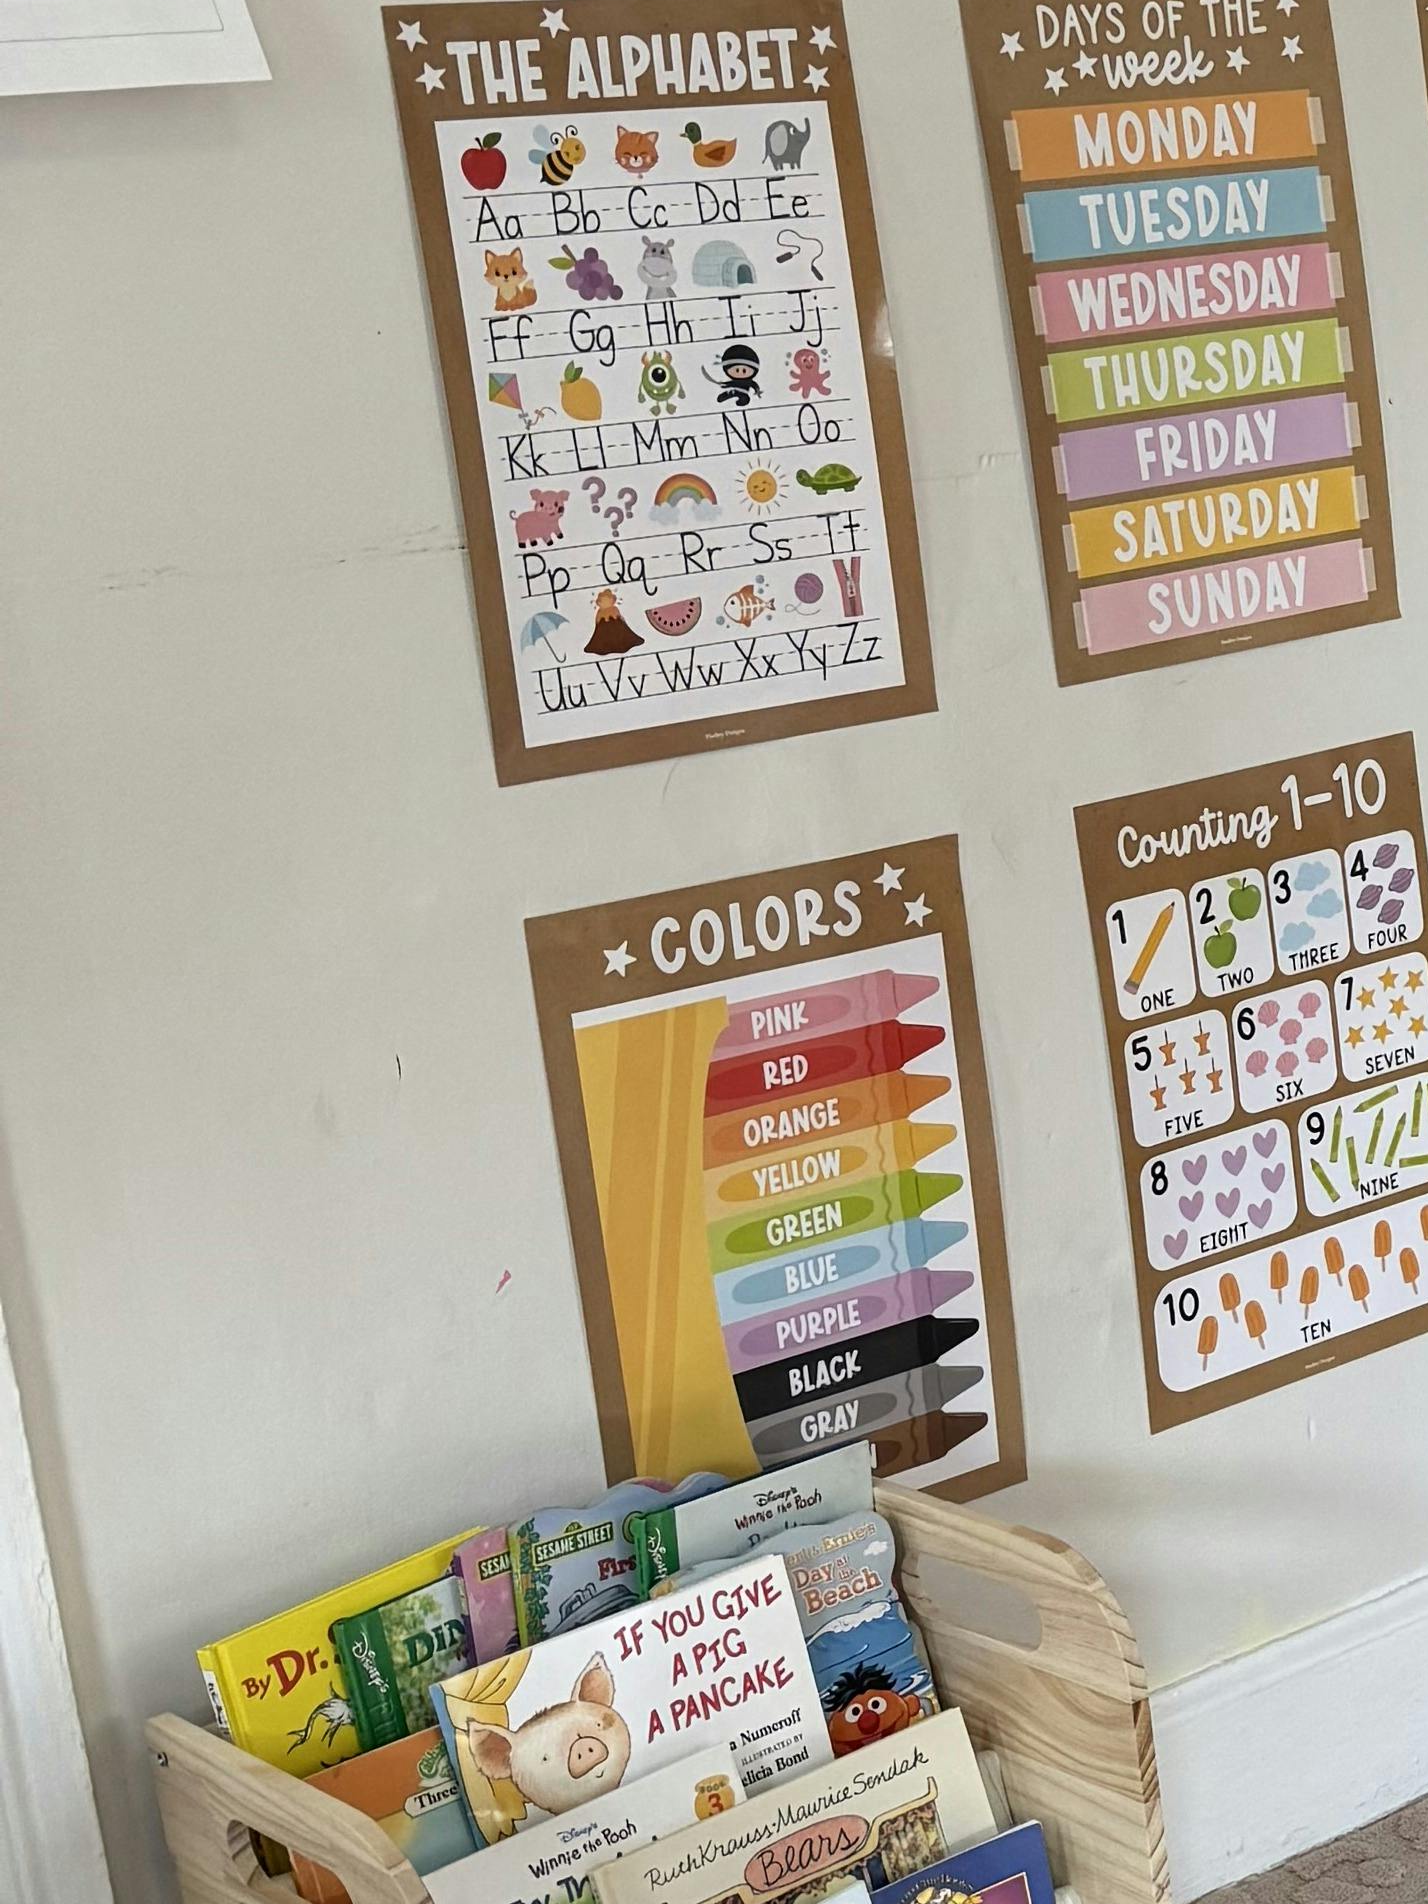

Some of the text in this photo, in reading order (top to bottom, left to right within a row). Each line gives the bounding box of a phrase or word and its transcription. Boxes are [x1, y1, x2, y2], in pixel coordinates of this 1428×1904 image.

[1035, 4, 1126, 51] DAYS
[1141, 0, 1184, 41] OF
[446, 28, 798, 106] THE ALPHABET
[1102, 37, 1215, 90] week
[1074, 101, 1257, 169] MONDAY
[474, 176, 810, 242] Aa Bb Cc Dd Ee
[1079, 179, 1269, 250] TUESDAY
[1066, 253, 1302, 333] WEDNESDAY
[1084, 331, 1305, 410] THURSDAY
[1135, 409, 1277, 481] FRIDAY
[1113, 480, 1320, 562] SATURDAY
[1147, 556, 1307, 635] SUNDAY
[1117, 757, 1386, 869] Counting 1-10
[650, 881, 862, 975] COLORS
[1368, 924, 1408, 948] FOUR
[1140, 988, 1176, 1008] ONE
[1216, 967, 1255, 992] TWO
[751, 1000, 808, 1039] PINK
[763, 1055, 808, 1089] RED
[1365, 1046, 1416, 1074] SEVEN
[743, 1100, 840, 1147] ORANGE
[1165, 1110, 1204, 1137] FIVE
[766, 1202, 843, 1246] GREEN
[785, 1257, 838, 1293] BLUE
[789, 1352, 861, 1396] BLACK
[800, 1401, 859, 1443] GRAY
[536, 1522, 613, 1562] SESAME STREET
[795, 1558, 835, 1590] Day
[805, 1570, 882, 1616] Beach
[614, 1573, 782, 1661] IF YOU GIVE
[243, 1645, 328, 1700] By Dr.
[672, 1628, 747, 1687] A PIG
[648, 1656, 794, 1744] A PANCAKE
[529, 1846, 582, 1880] Winnie
[604, 1819, 637, 1848] Pooh
[760, 1823, 859, 1886] Bears
